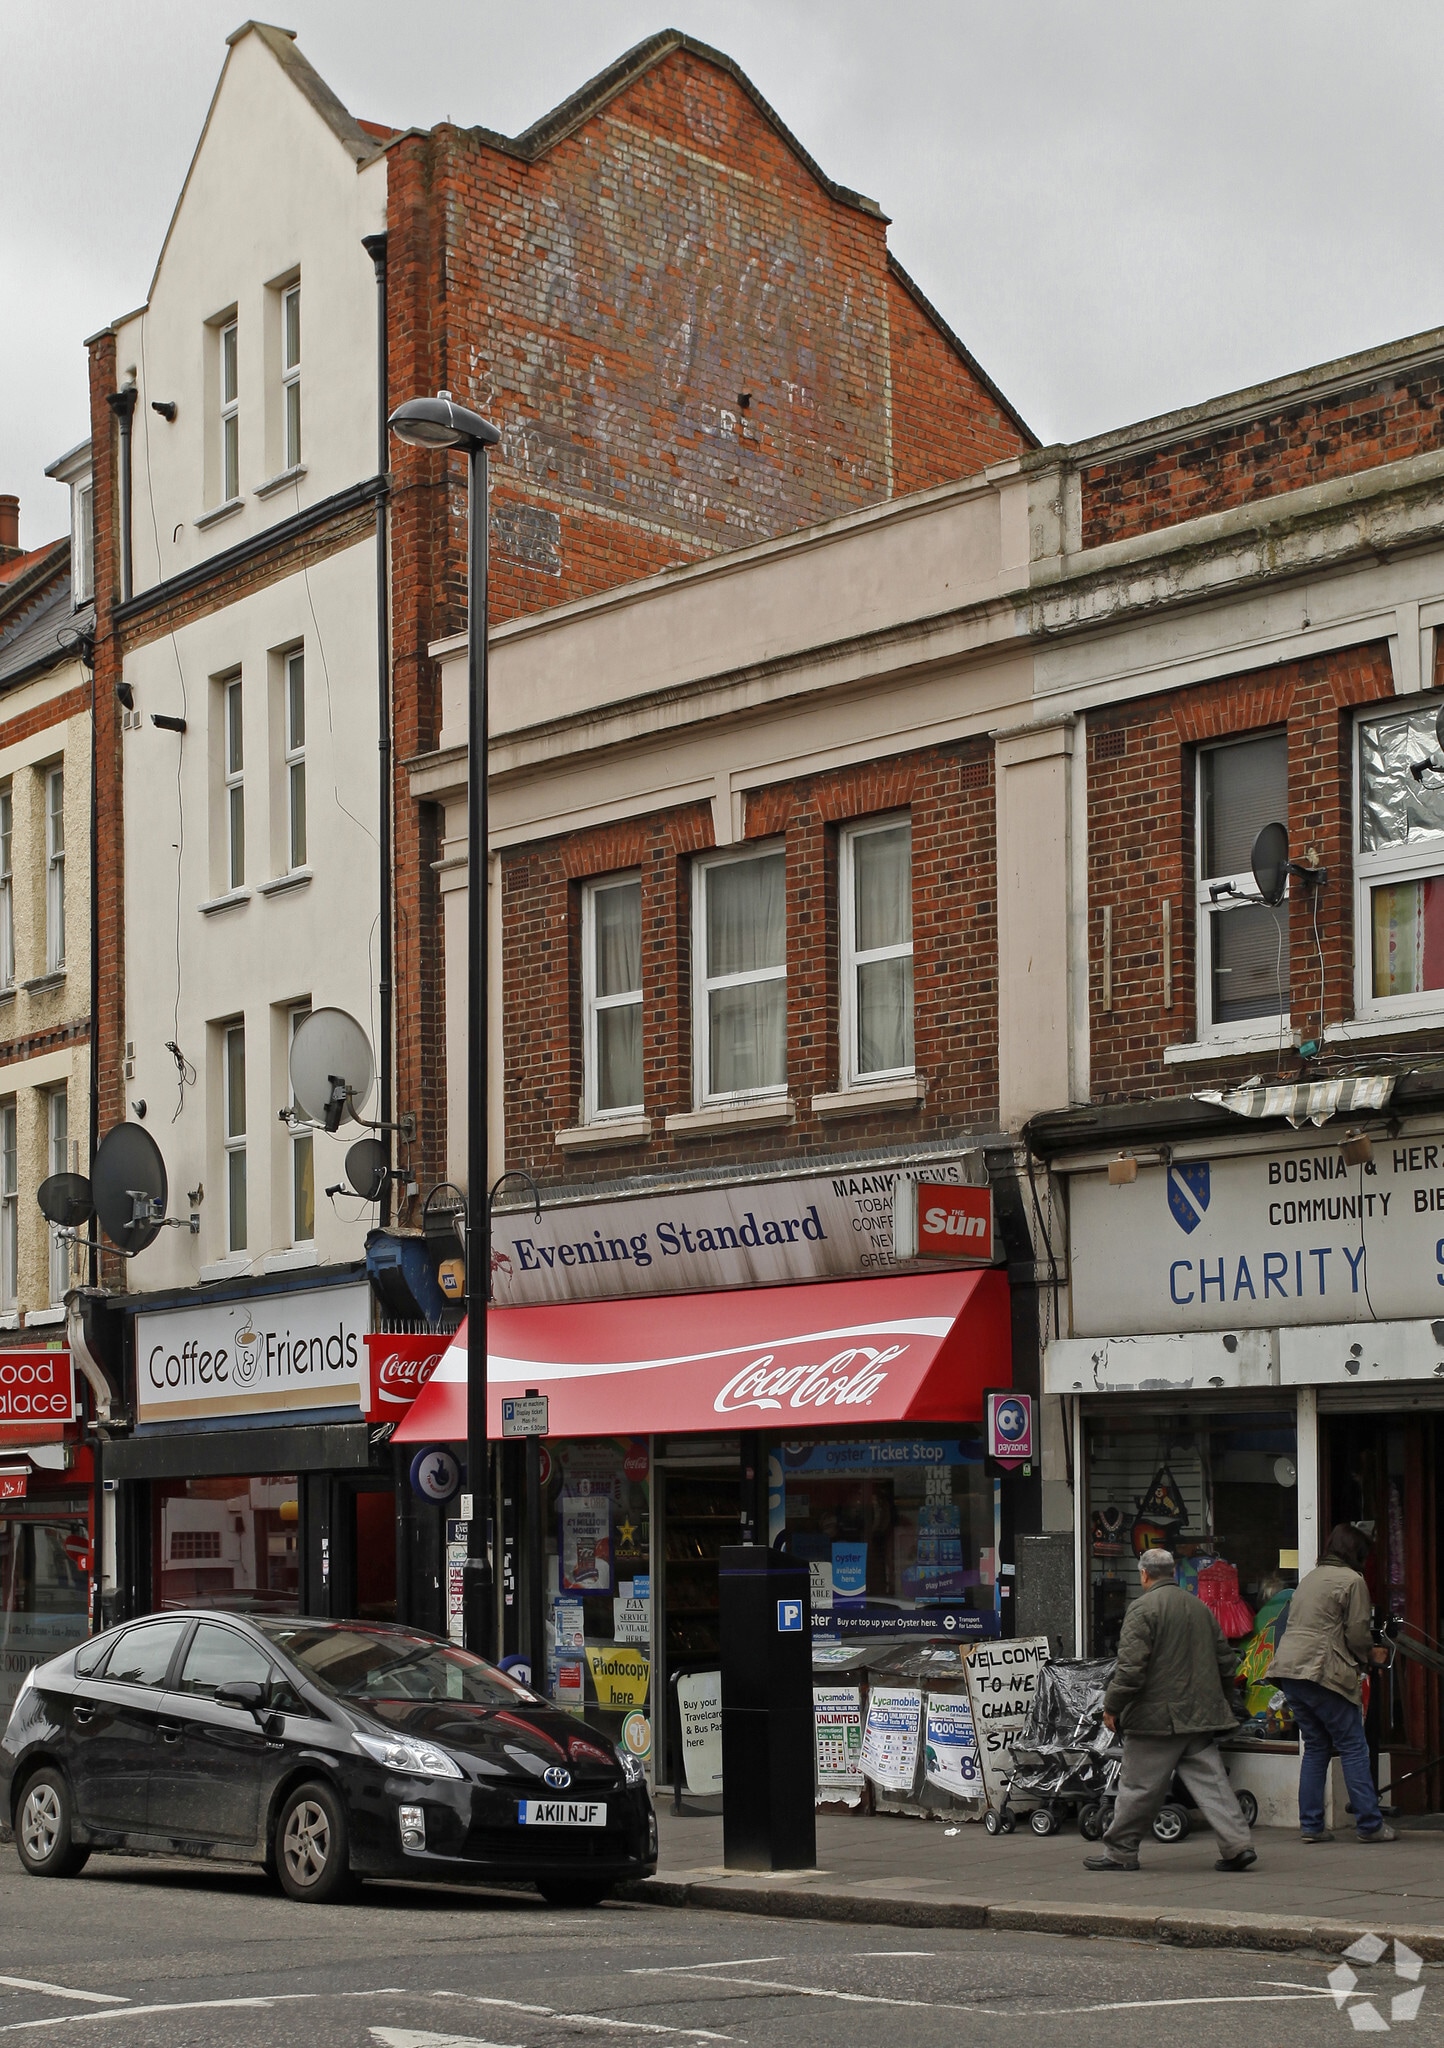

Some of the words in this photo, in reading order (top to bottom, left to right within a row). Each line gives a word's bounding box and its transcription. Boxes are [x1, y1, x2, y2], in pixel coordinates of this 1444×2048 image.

[1268, 1155, 1348, 1185] BOSNIA
[1392, 1145, 1444, 1173] HER
[855, 1198, 894, 1213] TOBA
[951, 1209, 965, 1217] THE
[1269, 1192, 1392, 1226] COMMUNITY
[922, 1207, 987, 1238] Sun
[512, 1230, 652, 1272] Evening
[655, 1205, 828, 1257] Standard
[870, 1232, 894, 1248] NE
[860, 1251, 905, 1267] GREE
[1169, 1246, 1366, 1305] CHARITY
[149, 1339, 229, 1389] Coffee
[242, 1350, 255, 1377] &
[265, 1321, 358, 1378] Friends
[505, 1404, 513, 1419] P
[826, 1449, 865, 1464] oyster
[869, 1445, 909, 1461] Ticket
[912, 1443, 944, 1462] Stop
[998, 1443, 1029, 1454] payzone
[925, 1465, 952, 1479] THE
[926, 1479, 952, 1495] BIG
[926, 1495, 952, 1506] ONE
[577, 1518, 606, 1526] MILLION
[930, 1527, 961, 1536] MILLION
[835, 1553, 862, 1563] oyster
[925, 1582, 938, 1590] play
[939, 1579, 953, 1587] here
[626, 1599, 644, 1609] FAX
[784, 1605, 798, 1627] P
[837, 1617, 850, 1627] Buy
[859, 1617, 871, 1627] top
[871, 1619, 881, 1627] up
[881, 1619, 896, 1627] your
[897, 1618, 920, 1628] Oyster
[920, 1618, 938, 1627] here.
[0, 1655, 26, 1672] OOD
[592, 1656, 649, 1682] Photocopy
[976, 1676, 1002, 1693] TO
[1009, 1674, 1037, 1693] NE
[610, 1685, 634, 1704] here
[818, 1693, 854, 1702] Lycamobile
[872, 1695, 920, 1707] Lycamobile
[683, 1700, 697, 1710] Buy
[700, 1698, 717, 1709] your
[816, 1714, 859, 1724] UNLIMITED
[870, 1712, 889, 1722] 250
[686, 1726, 692, 1735] &
[694, 1725, 708, 1734] Bus
[930, 1722, 955, 1734] 1000
[686, 1739, 704, 1748] here
[961, 1756, 976, 1780] 8
[535, 1804, 564, 1822] AK11
[568, 1804, 599, 1822] NJF
